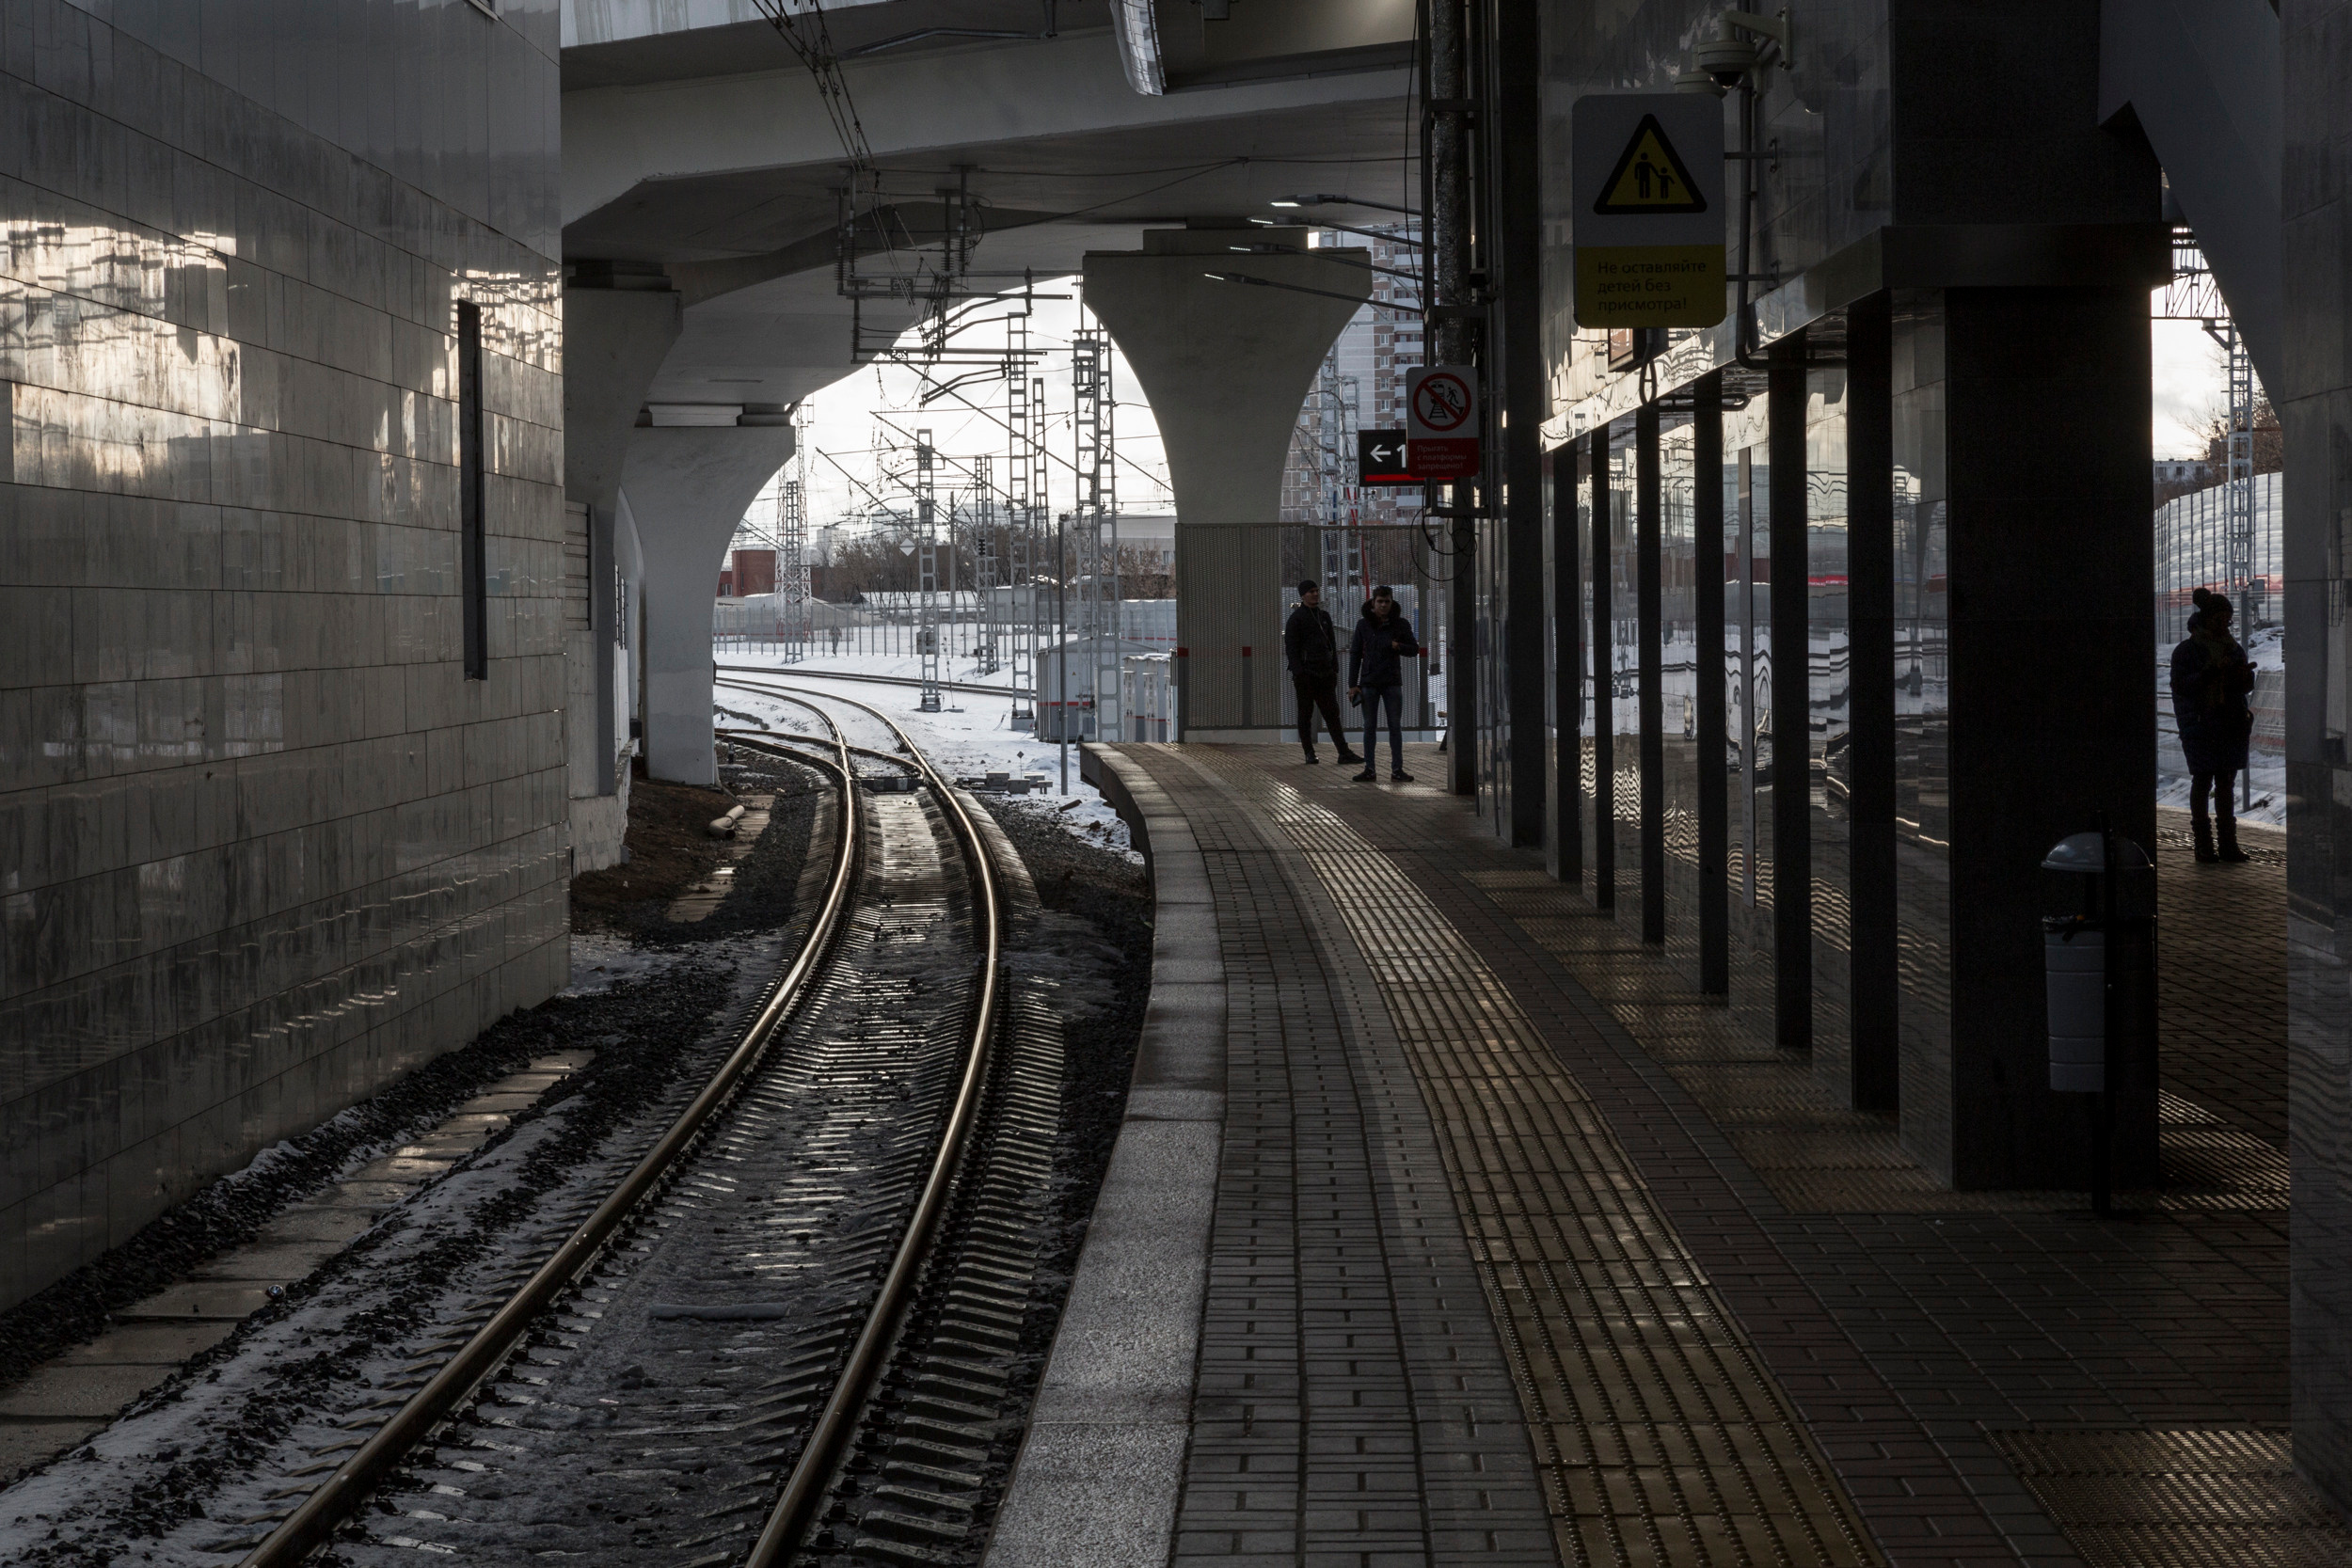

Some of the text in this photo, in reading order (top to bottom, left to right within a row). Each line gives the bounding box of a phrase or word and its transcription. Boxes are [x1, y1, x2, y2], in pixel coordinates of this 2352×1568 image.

[1597, 259, 1707, 274] Не оставляйте
[1597, 278, 1672, 294] детей без
[1598, 297, 1687, 313] присмотра!
[1396, 444, 1406, 468] 1
[1422, 453, 1467, 462] платформы
[1417, 462, 1462, 471] запрещено!
